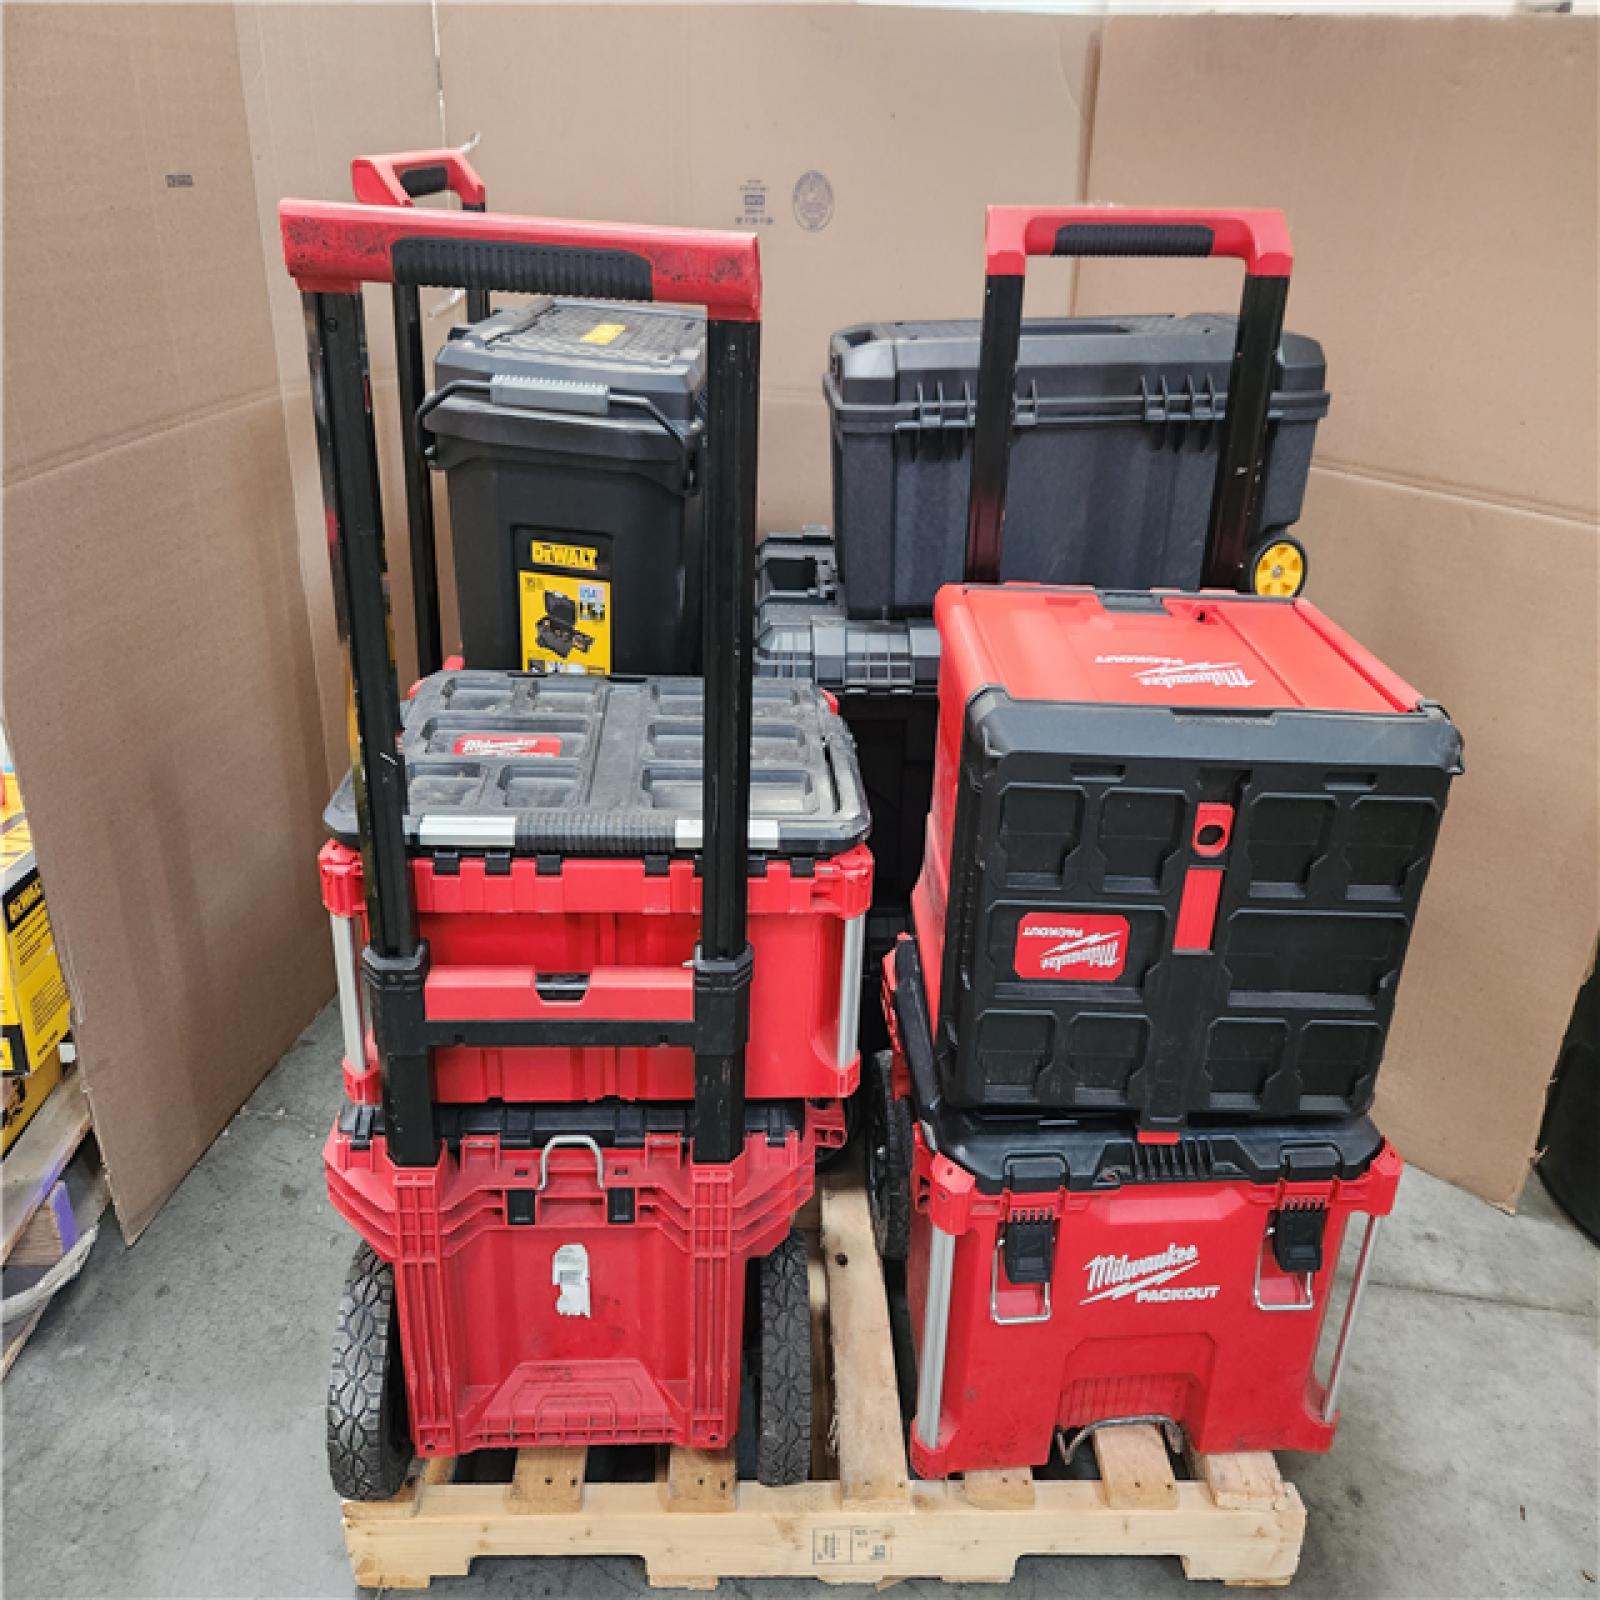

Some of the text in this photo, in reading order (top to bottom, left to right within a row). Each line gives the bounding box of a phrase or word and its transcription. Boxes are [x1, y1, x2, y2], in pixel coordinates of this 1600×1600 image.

[1139, 668, 1256, 689] Milwaukee
[1022, 926, 1084, 939] PACKOUT
[1040, 940, 1120, 973] Milwaukee
[1082, 1242, 1198, 1292] Milwaukee
[1135, 1285, 1221, 1303] PACKOUT
